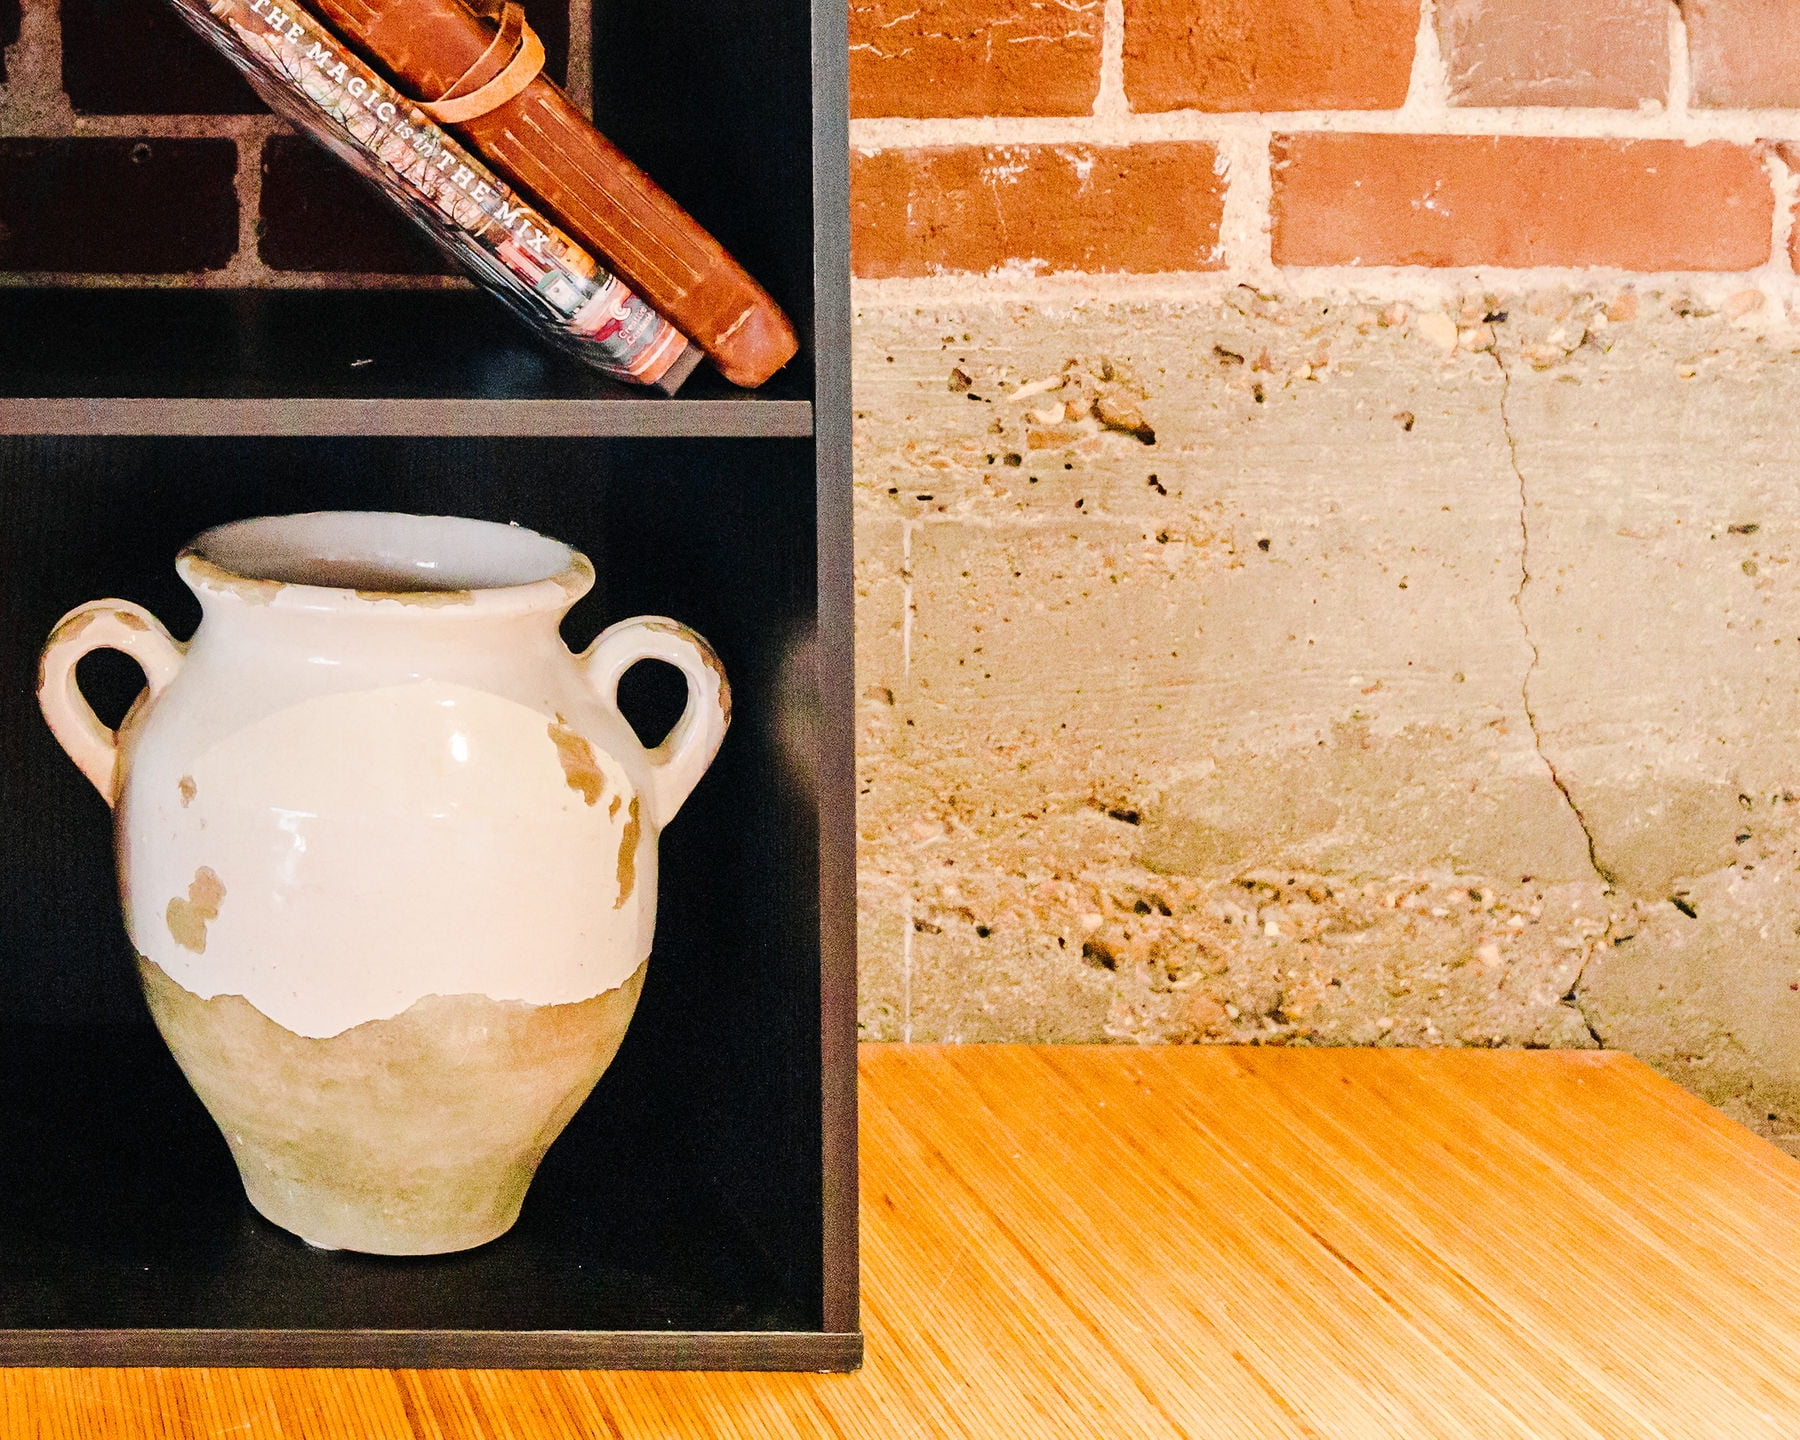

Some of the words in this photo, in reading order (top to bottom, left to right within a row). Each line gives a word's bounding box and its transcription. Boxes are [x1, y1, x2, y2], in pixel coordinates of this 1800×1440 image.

[306, 41, 396, 122] MAGIC
[395, 118, 415, 141] is
[437, 150, 491, 202] THE
[494, 200, 550, 254] MIX
